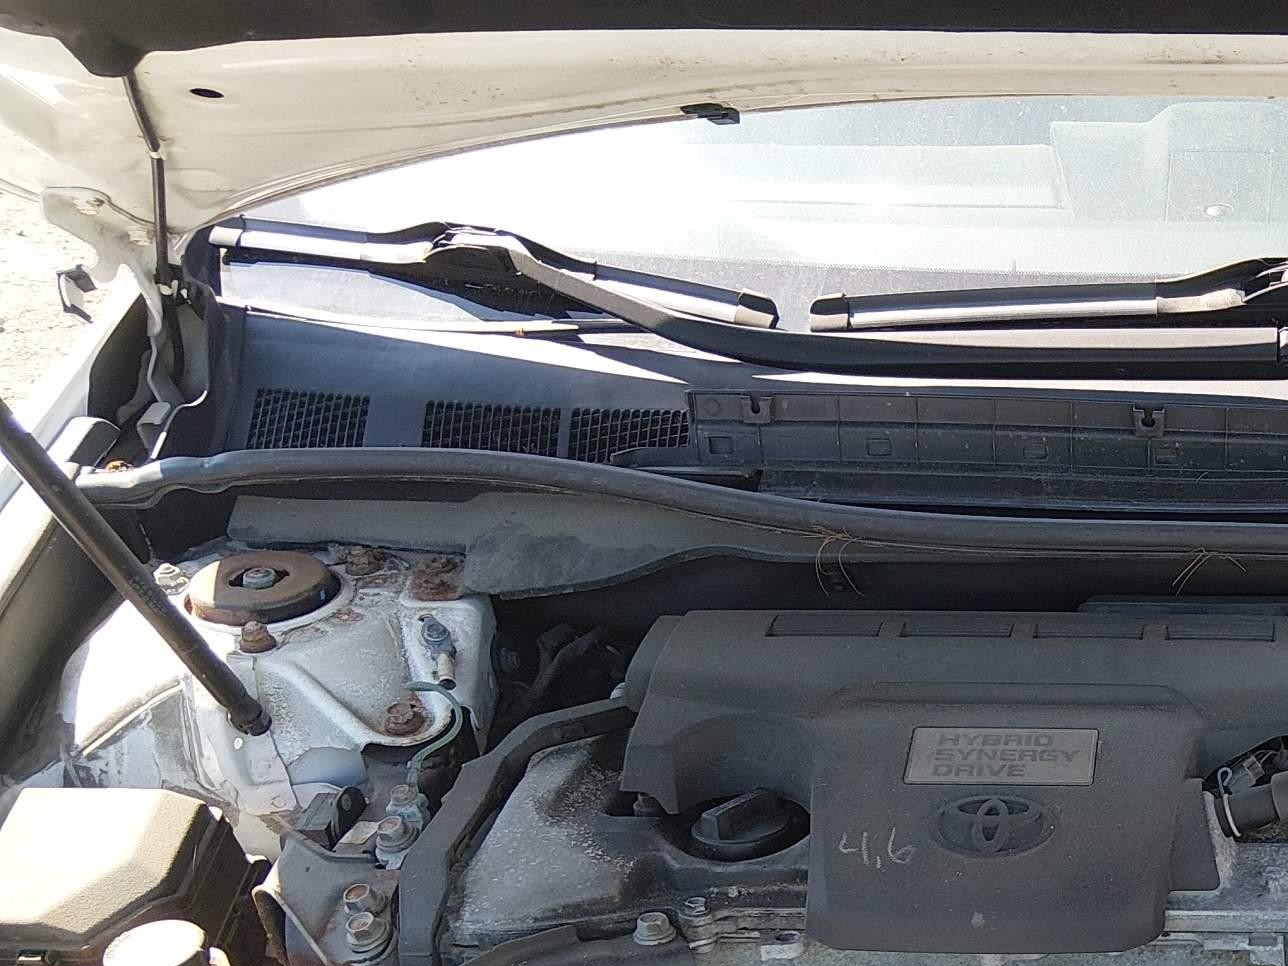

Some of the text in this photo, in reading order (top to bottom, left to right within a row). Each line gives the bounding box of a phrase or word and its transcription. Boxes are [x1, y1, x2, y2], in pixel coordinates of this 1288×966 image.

[939, 733, 1055, 747] HYBRID
[933, 748, 1081, 763] SYNERGY
[931, 763, 1026, 778] DRIVE
